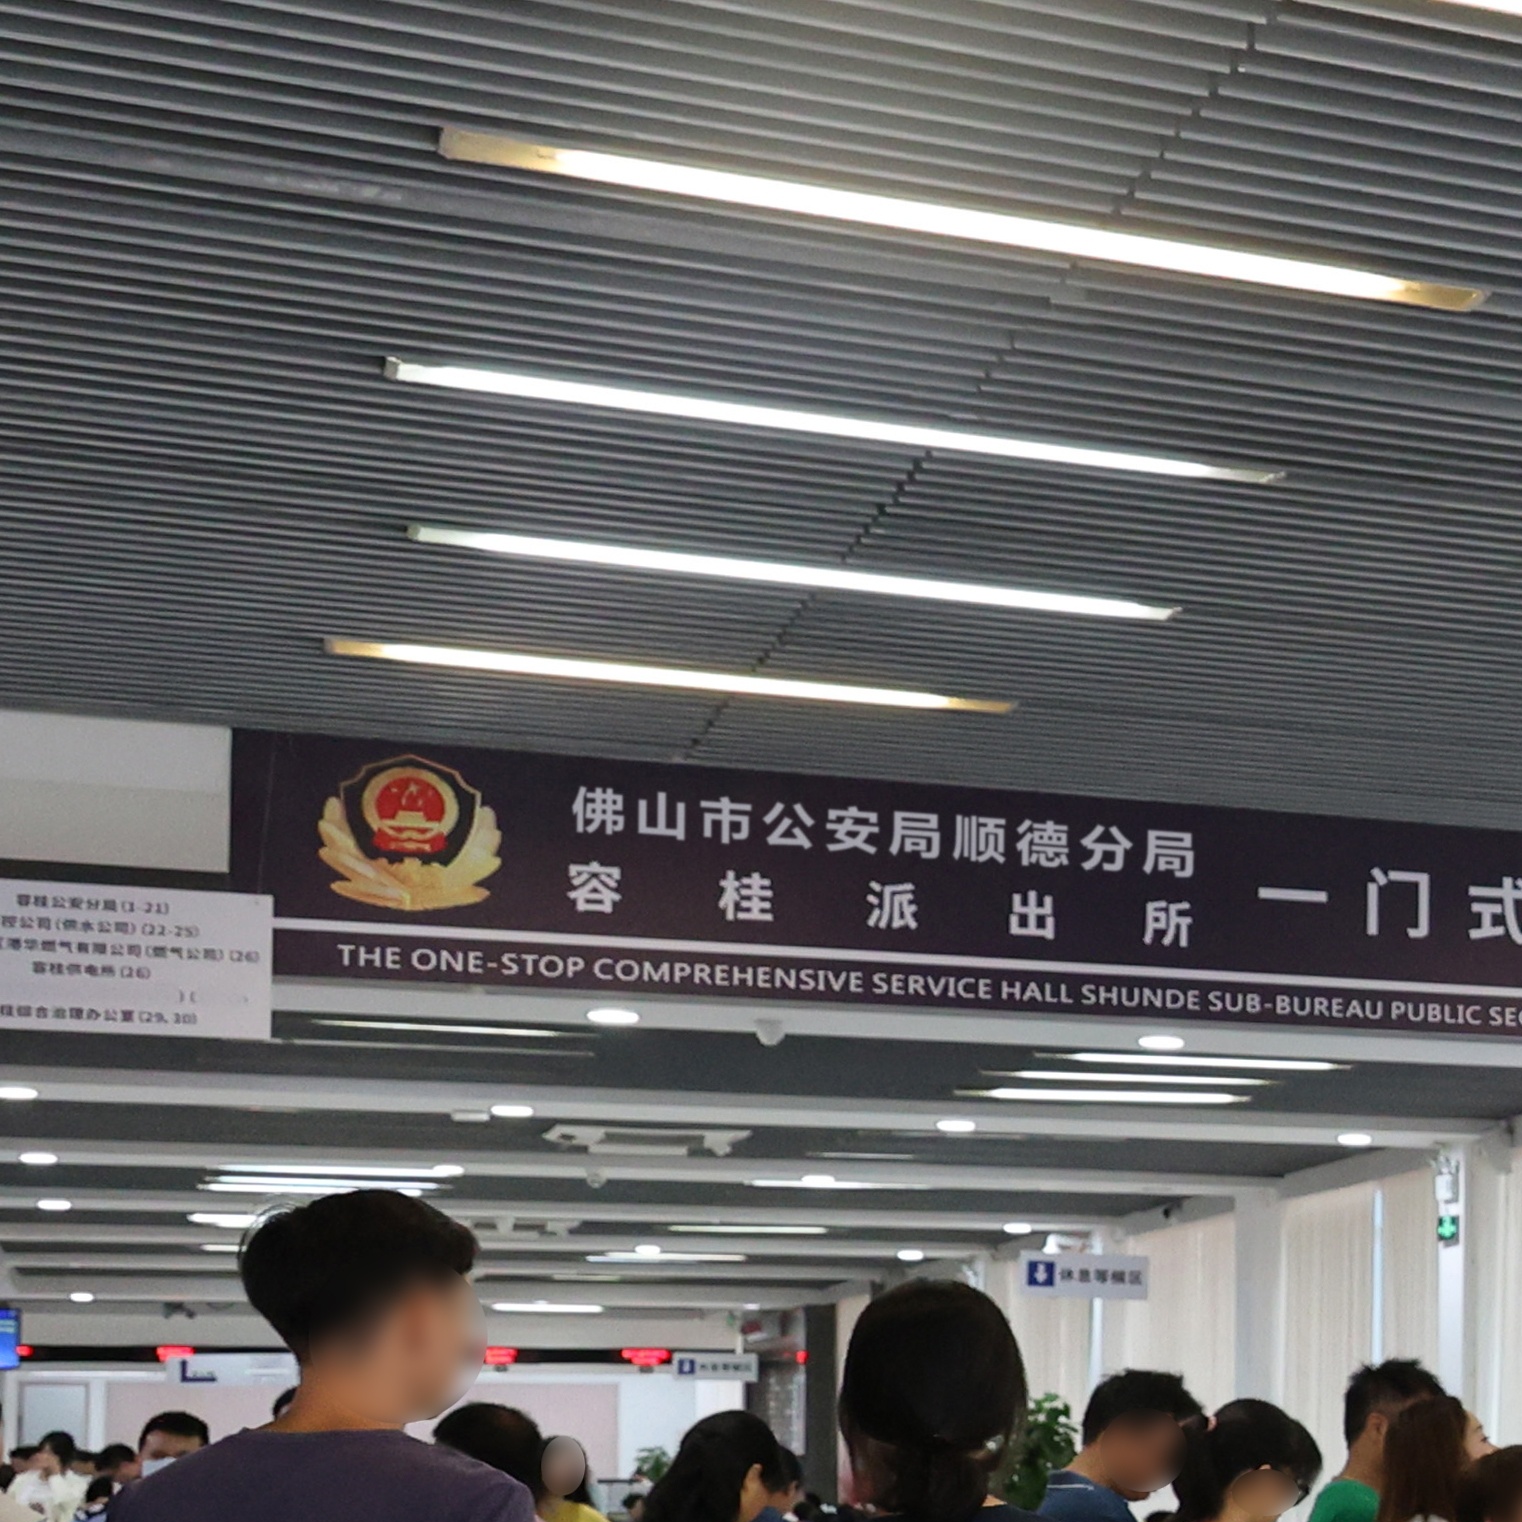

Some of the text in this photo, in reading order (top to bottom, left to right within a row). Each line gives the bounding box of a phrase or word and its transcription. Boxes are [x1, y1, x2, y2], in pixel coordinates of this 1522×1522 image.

[571, 785, 1196, 880] 佛山市公安局顺德分局
[567, 862, 1193, 950] 容桂派出所
[337, 944, 401, 970] THE
[411, 948, 585, 979] ONE-STOP
[593, 957, 863, 993] COMPREHENSIVE
[872, 972, 992, 999] SERVICE
[1001, 980, 1073, 1003] HALL
[1081, 984, 1200, 1010] SHUNDE
[1208, 991, 1383, 1020] SUB-BUREAU
[1391, 1001, 1482, 1025] PUBLIC
